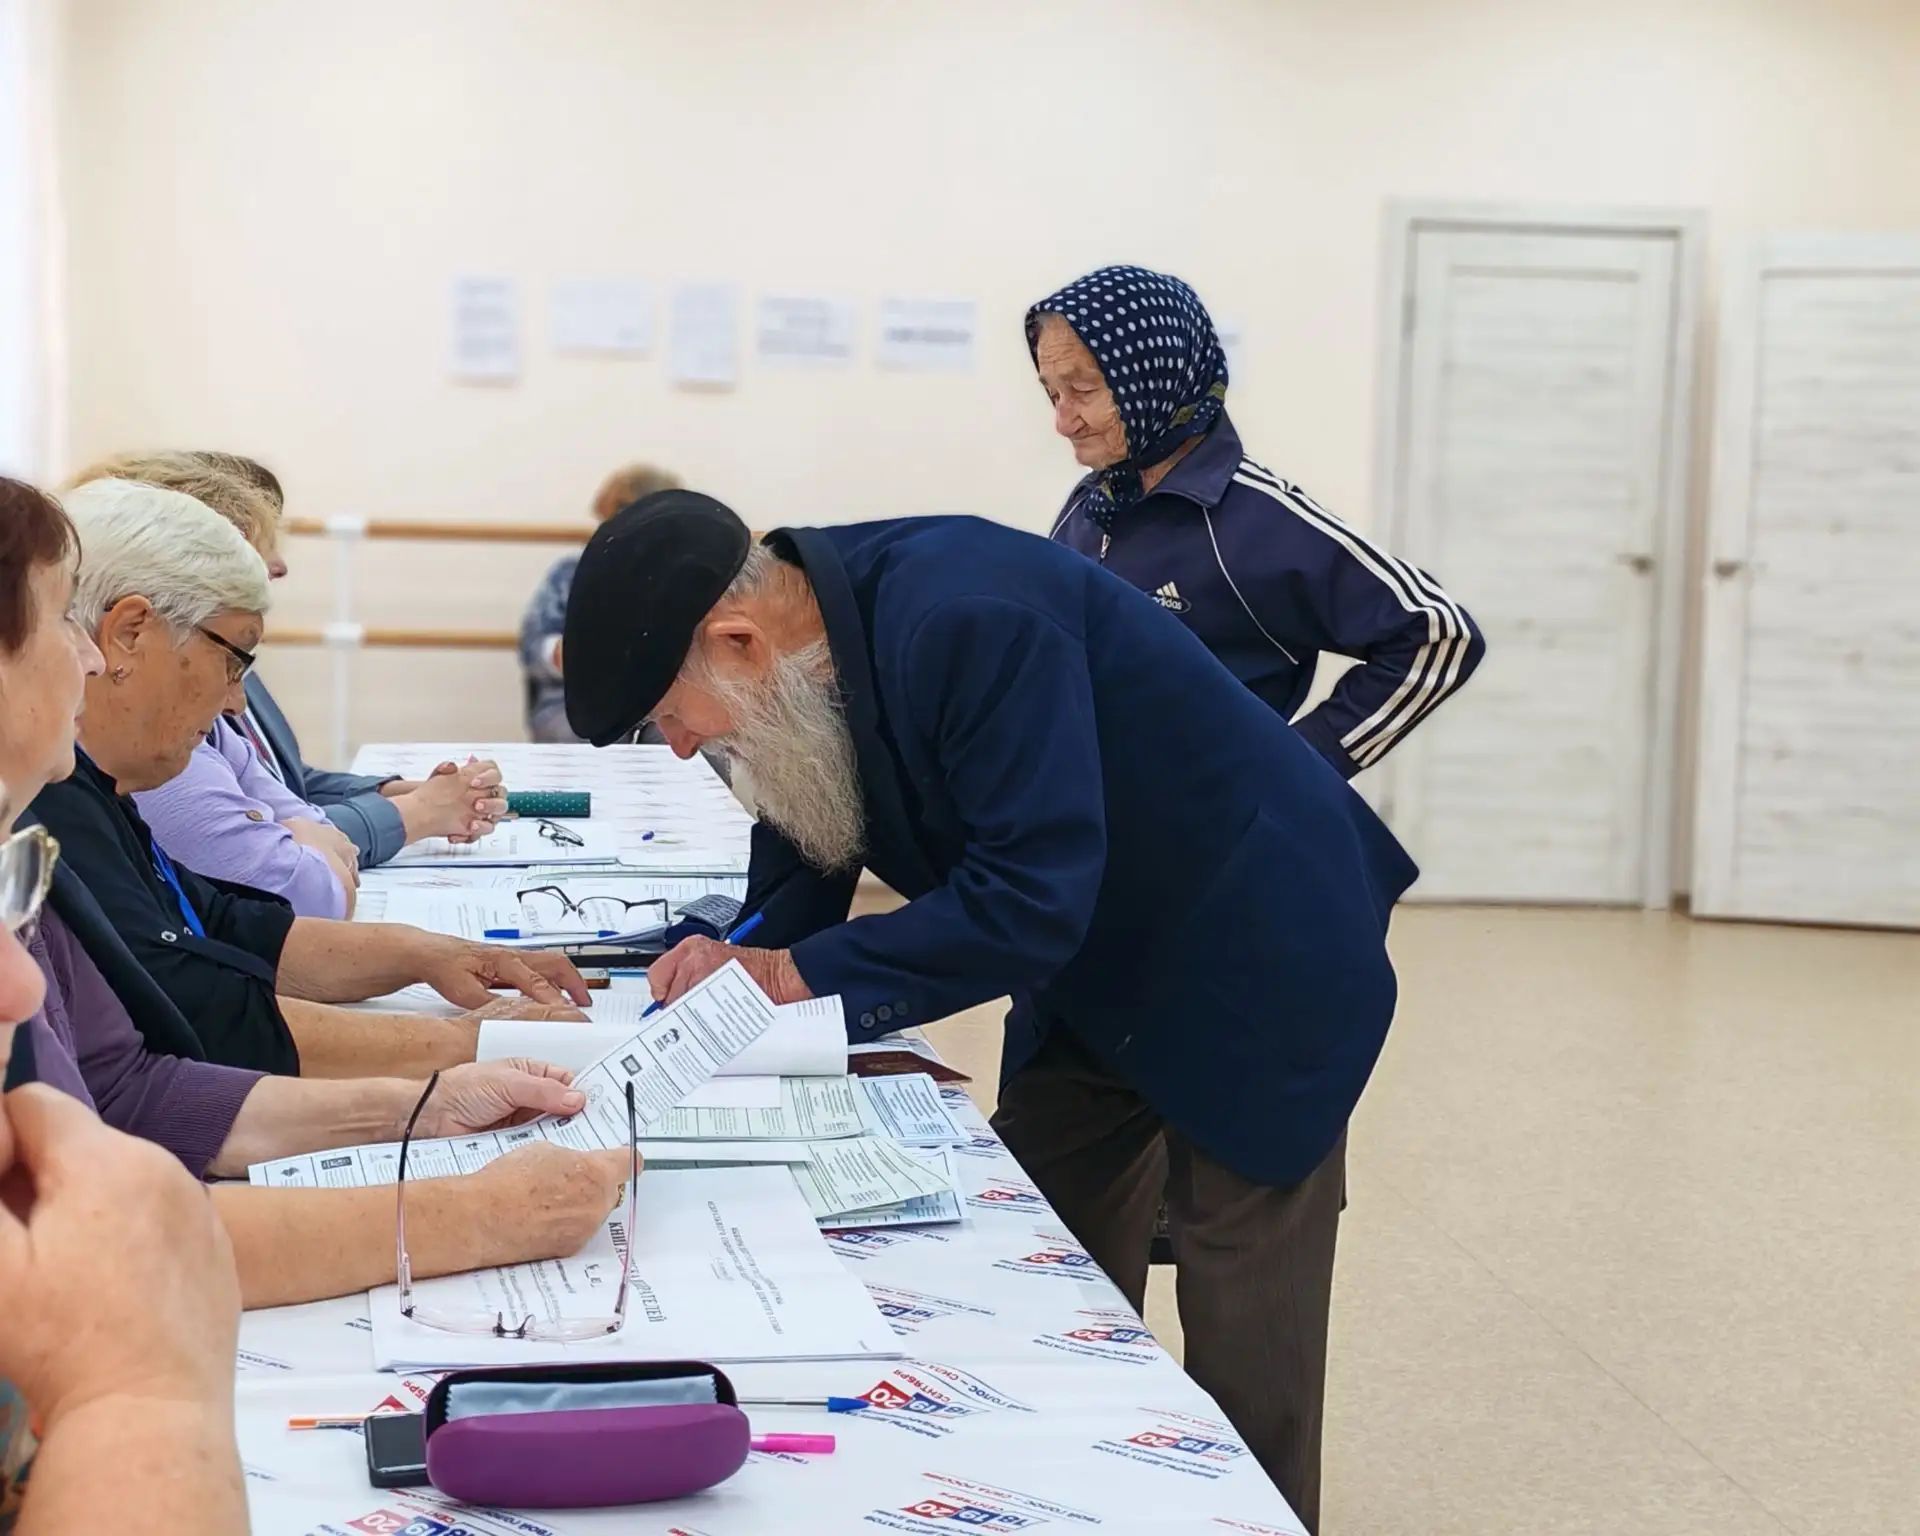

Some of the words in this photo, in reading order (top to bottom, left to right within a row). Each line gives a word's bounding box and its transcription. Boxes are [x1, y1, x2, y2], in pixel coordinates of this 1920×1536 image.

[1073, 1329, 1110, 1340] 20
[892, 1368, 952, 1403] СЕНТЯБРЯ
[869, 1387, 904, 1409] 20
[966, 1384, 1007, 1408] ГОЛОС
[909, 1400, 939, 1414] 19
[1136, 1434, 1175, 1448] 20
[1178, 1439, 1208, 1452] 19
[1214, 1443, 1244, 1455] 18
[912, 1502, 953, 1519] 20
[958, 1509, 990, 1523] 19
[361, 1513, 401, 1533] 20
[997, 1515, 1027, 1527] 18
